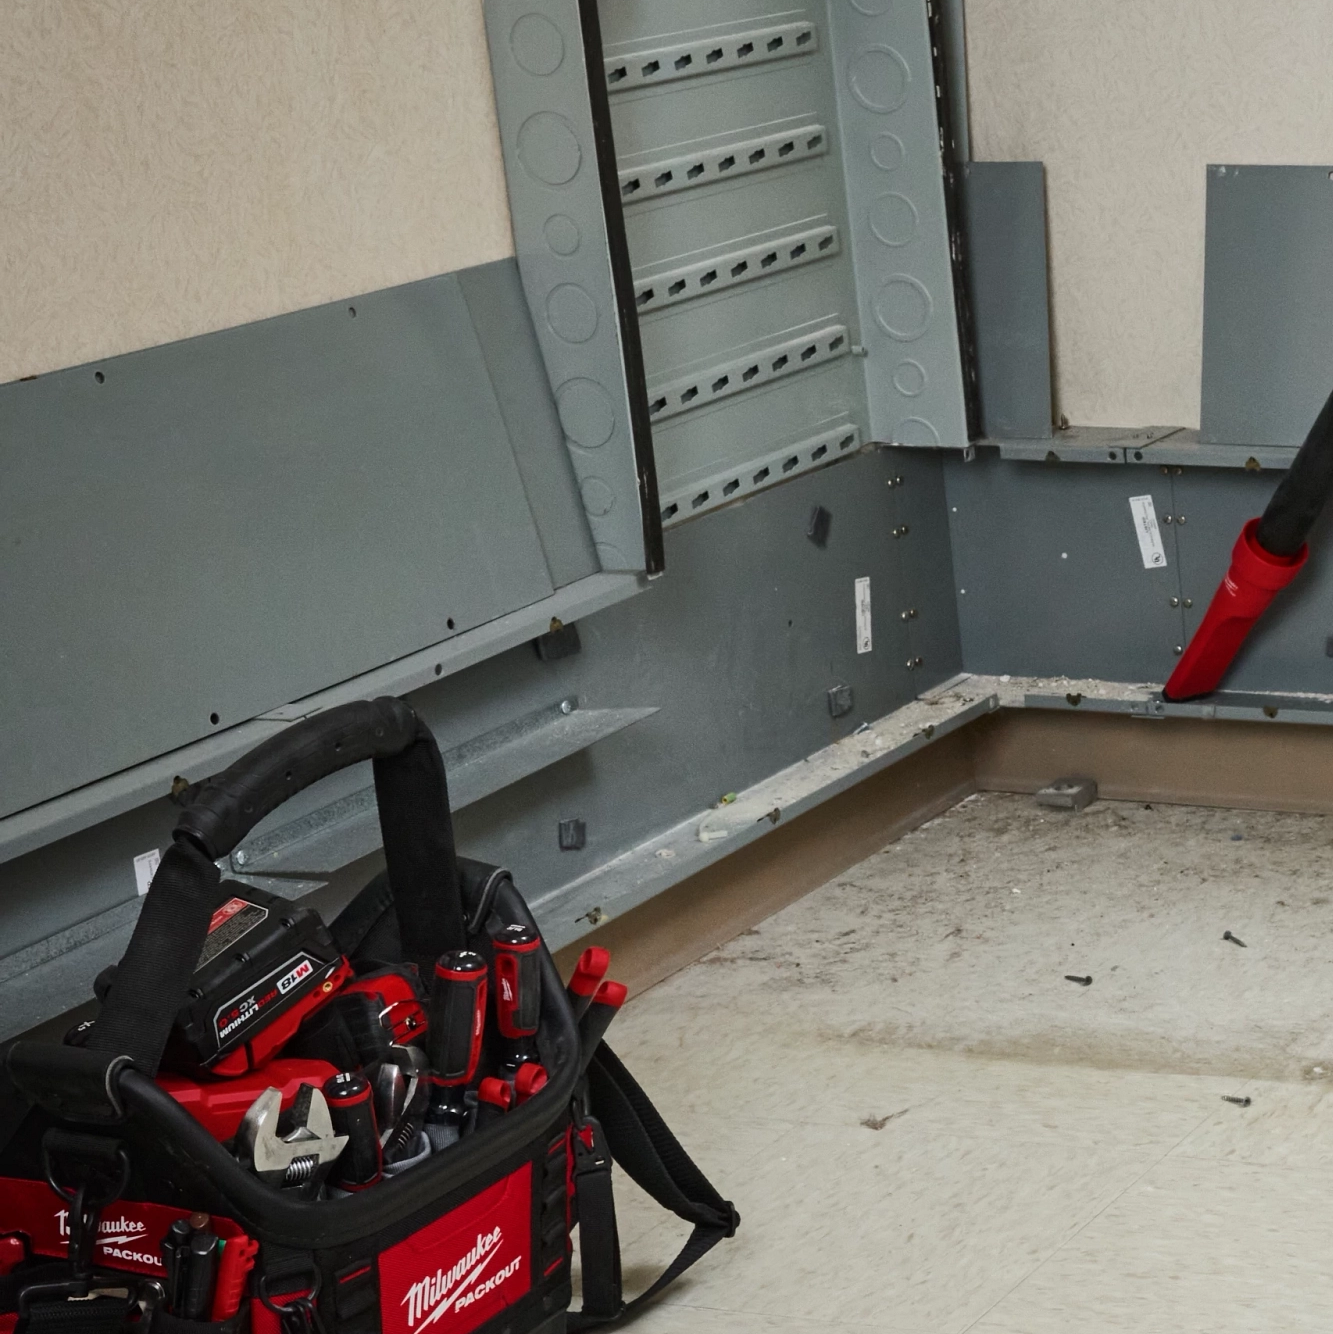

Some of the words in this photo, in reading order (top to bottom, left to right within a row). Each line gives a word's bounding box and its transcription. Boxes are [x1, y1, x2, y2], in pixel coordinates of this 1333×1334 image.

[281, 963, 310, 991] M18
[219, 988, 279, 1039] REDLITHIUM
[103, 1246, 163, 1267] PACKOU
[400, 1226, 502, 1327] Milwaukee
[454, 1255, 522, 1314] PACKOUT
